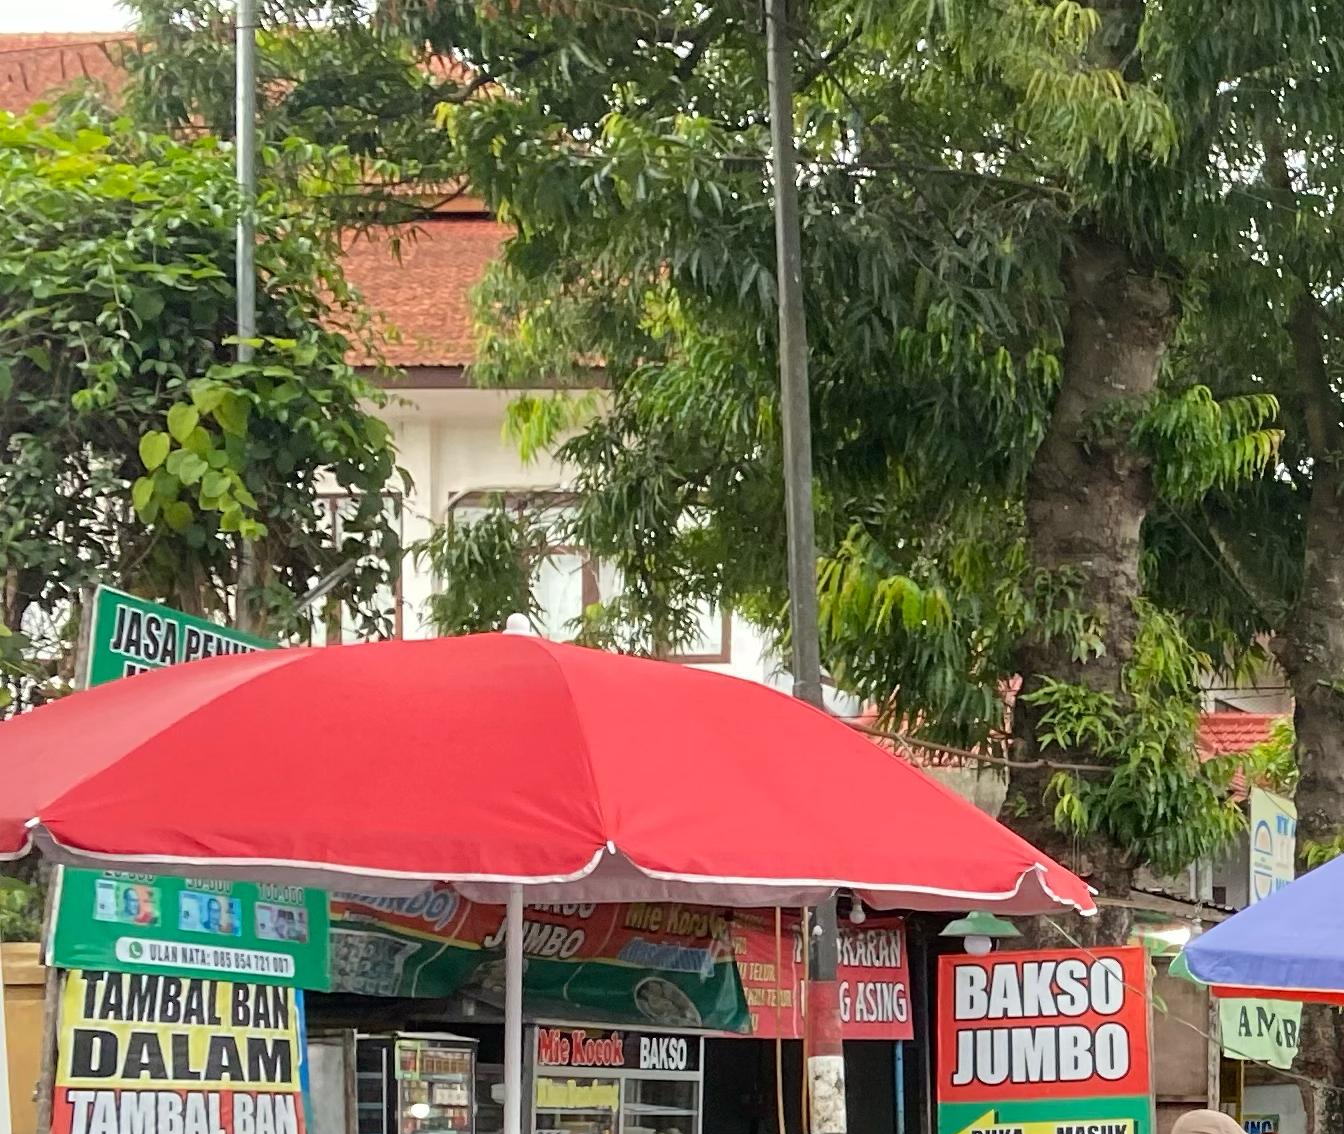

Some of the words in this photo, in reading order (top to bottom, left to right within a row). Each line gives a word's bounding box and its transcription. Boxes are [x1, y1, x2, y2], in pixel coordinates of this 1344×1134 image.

[111, 604, 178, 666] JASA
[150, 943, 178, 962] ULAN
[180, 947, 211, 967] NATA:
[485, 916, 586, 959] JMBO
[82, 969, 223, 1026] TAMBAL
[231, 981, 289, 1031] BAN
[855, 981, 907, 1023] ASING
[954, 957, 1125, 1020] BAKSO
[70, 1028, 293, 1084] DALAM
[538, 1029, 571, 1066] Mie
[571, 1029, 625, 1067] Kocok
[639, 1036, 688, 1071] BAKSO
[952, 1021, 1131, 1086] JUMBO
